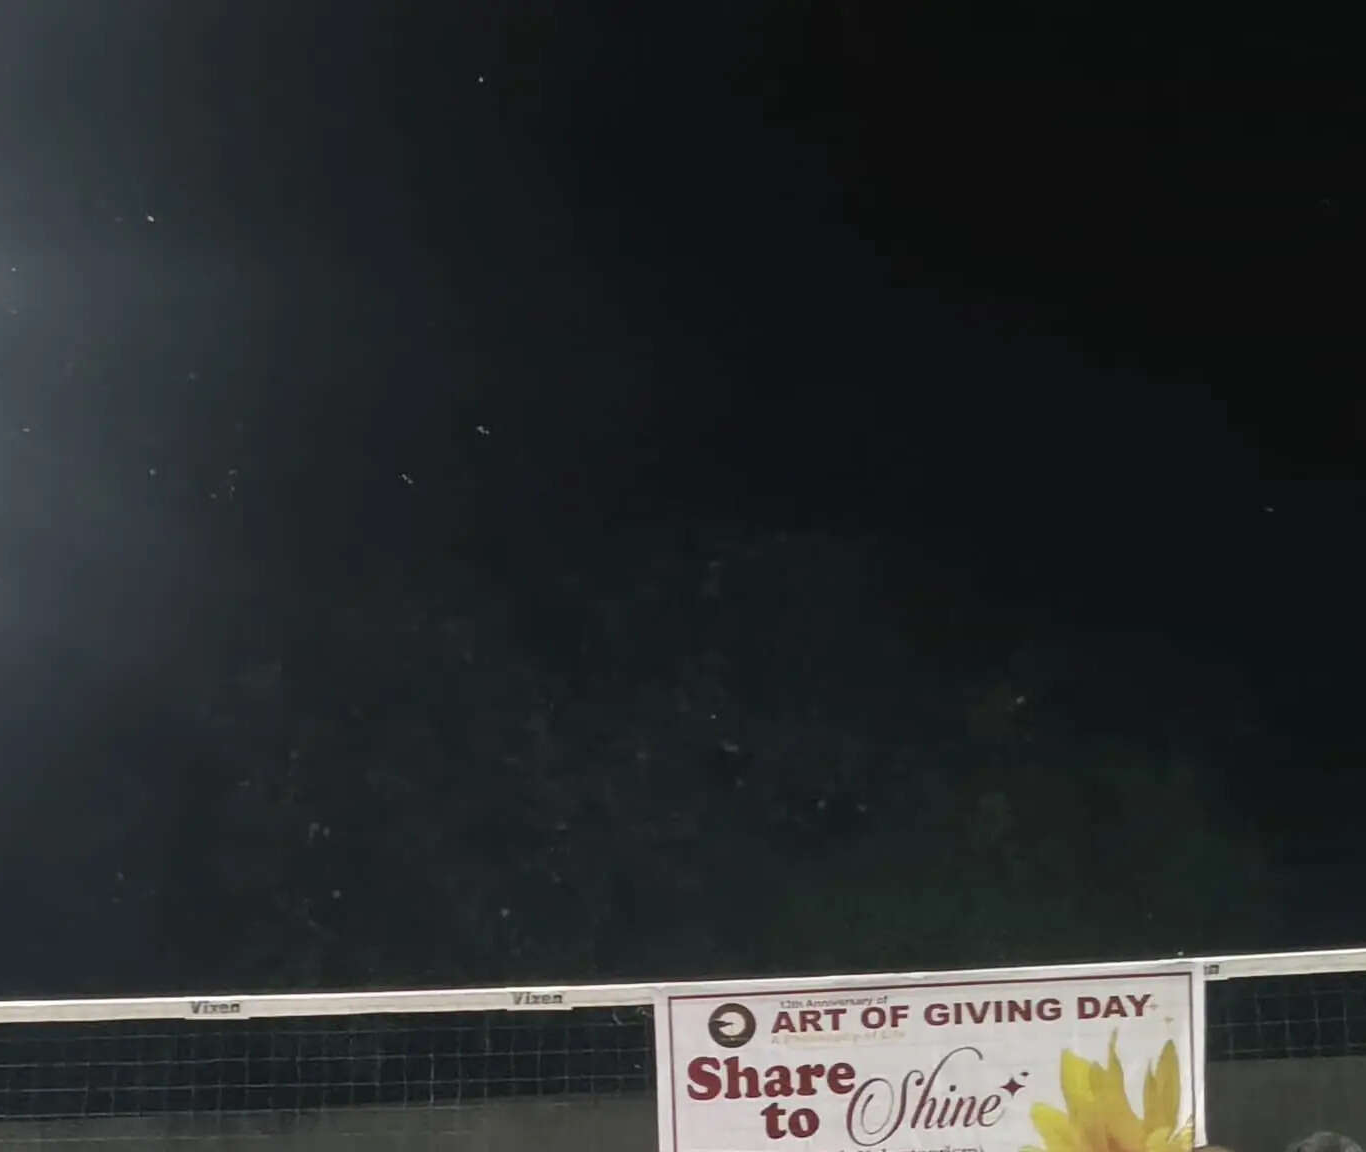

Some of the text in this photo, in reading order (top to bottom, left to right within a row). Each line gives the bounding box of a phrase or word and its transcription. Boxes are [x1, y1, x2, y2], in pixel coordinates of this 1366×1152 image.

[191, 1000, 241, 1015] Vixen
[512, 991, 564, 1006] Vixen
[771, 993, 1152, 1034] ART OF GIVING DAY
[686, 1055, 856, 1101] Share
[846, 1046, 1003, 1147] Shine
[761, 1102, 820, 1140] to
